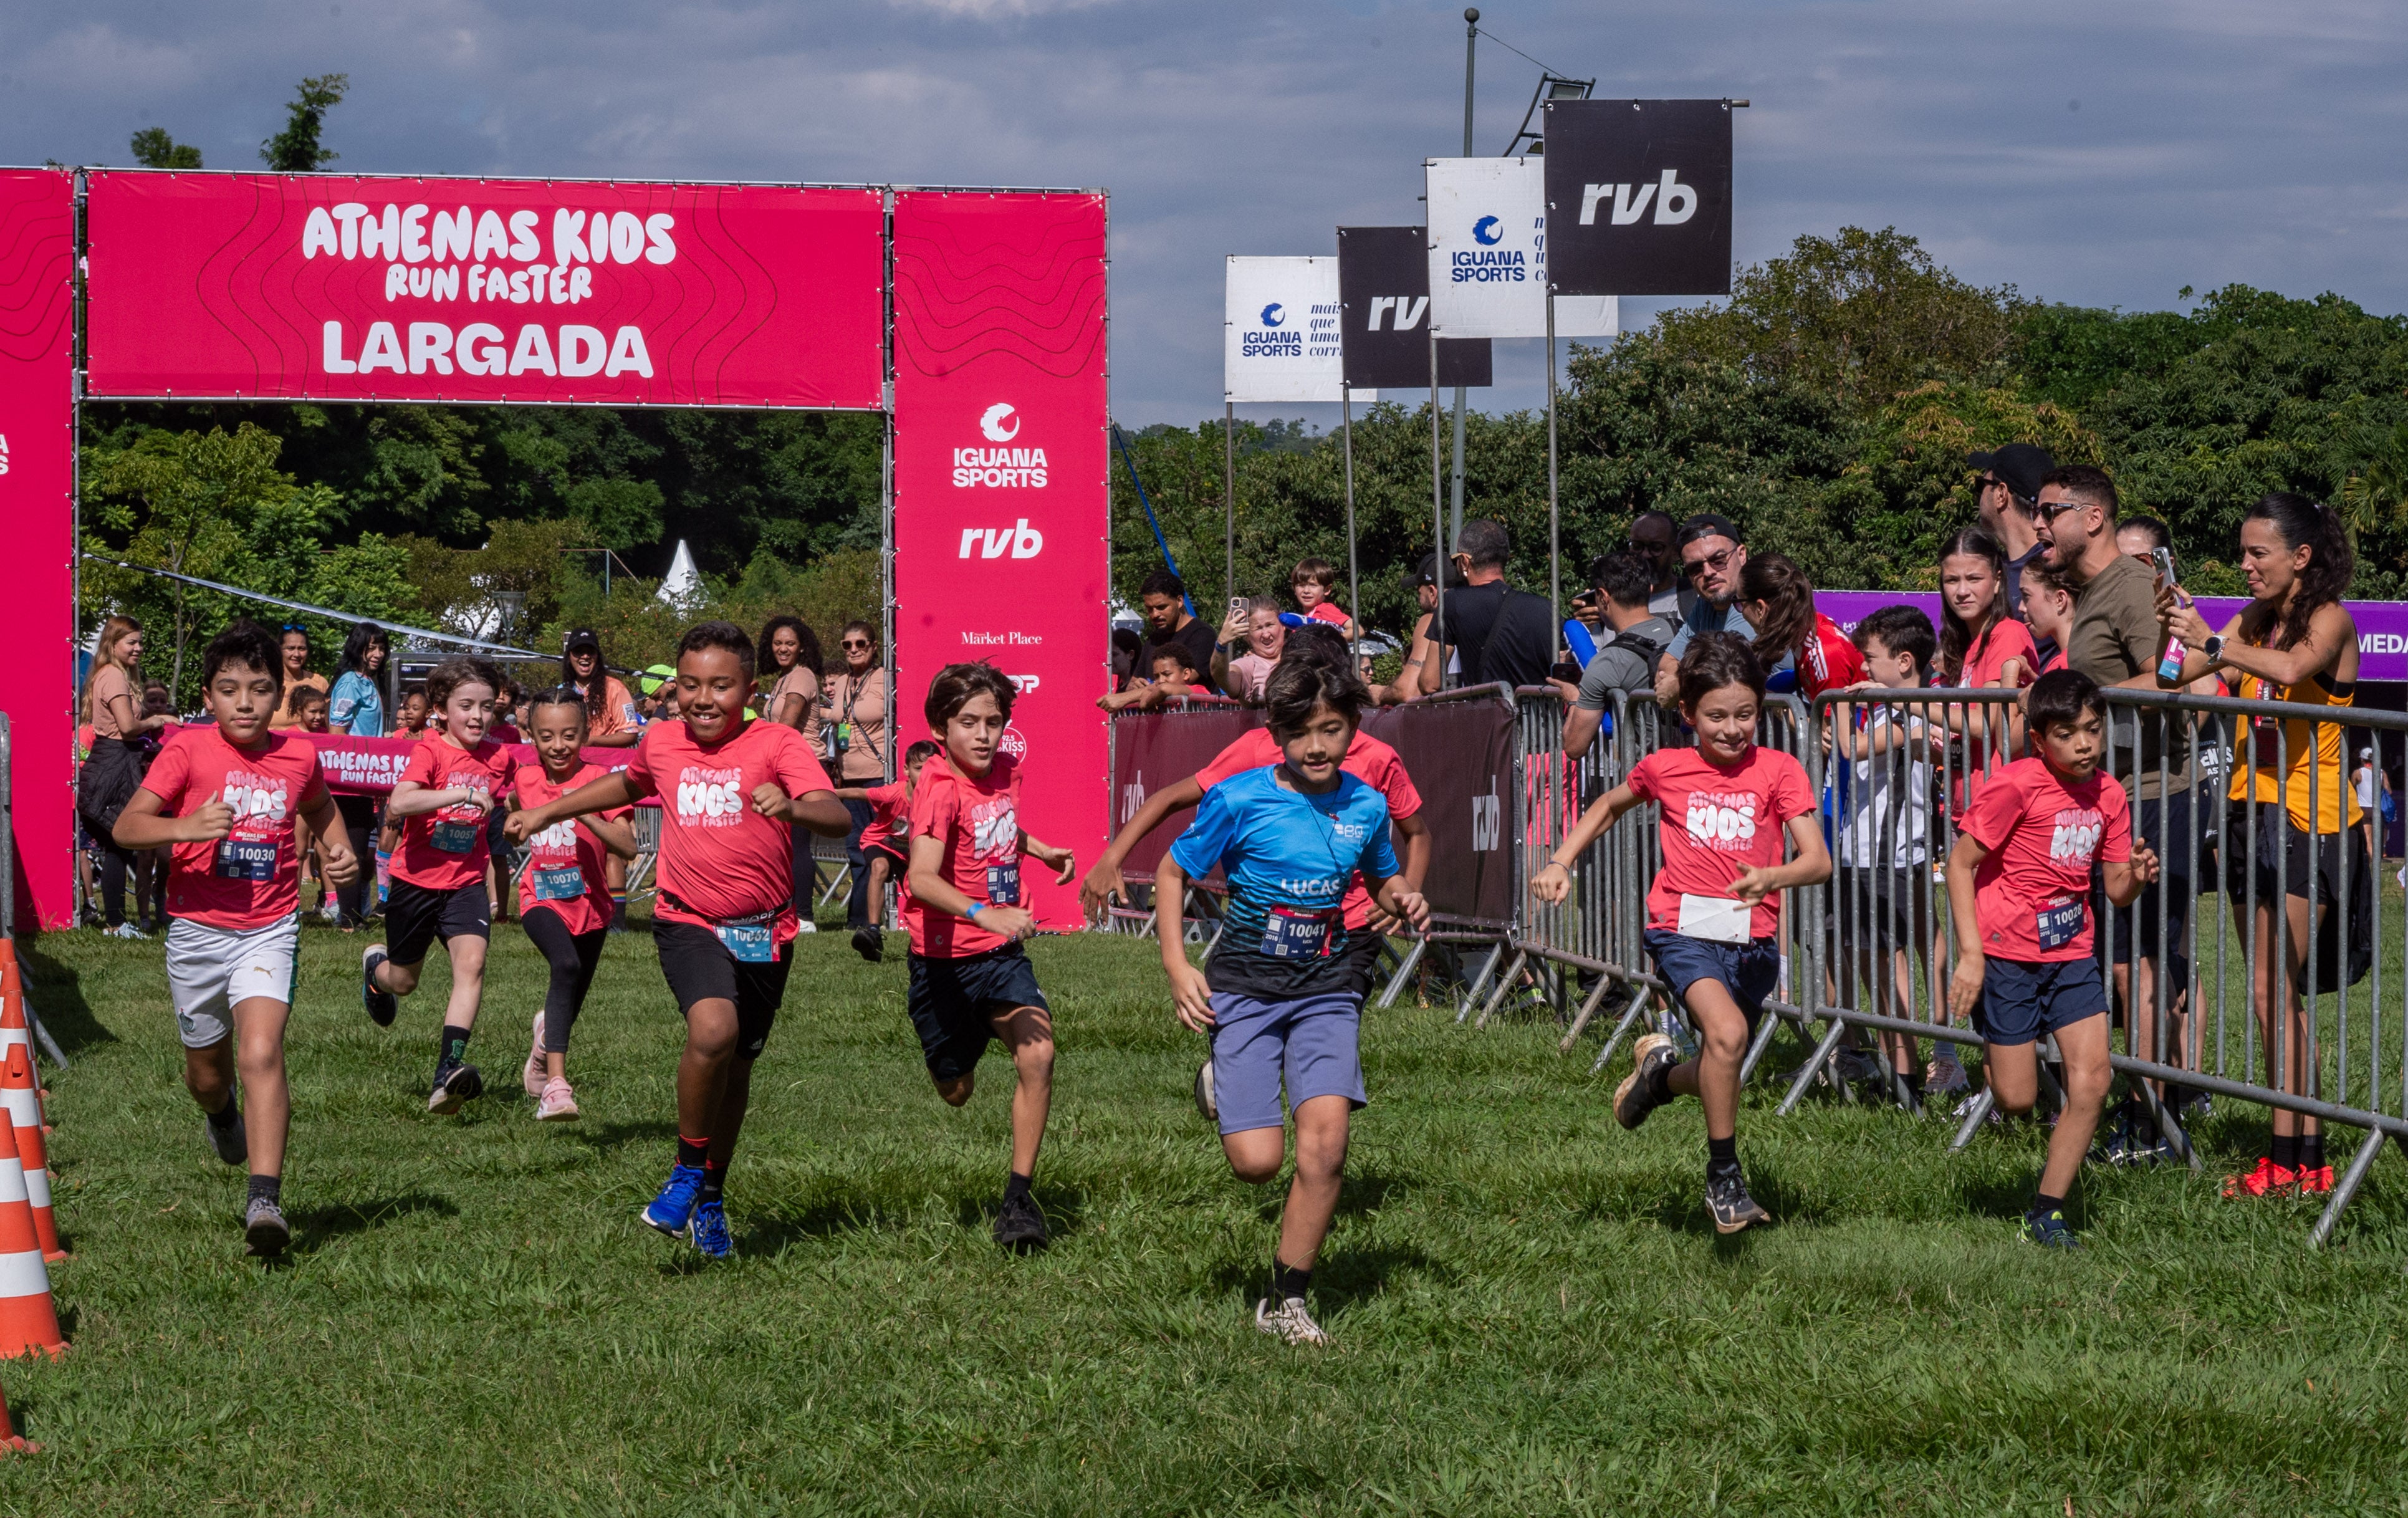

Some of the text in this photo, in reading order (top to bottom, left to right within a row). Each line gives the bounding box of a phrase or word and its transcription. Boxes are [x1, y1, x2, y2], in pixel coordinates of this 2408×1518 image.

[1579, 169, 1697, 226] rvb
[302, 203, 676, 267] ATHENAS KIDS
[1452, 251, 1525, 266] IGUANA
[385, 263, 593, 304] RUN FASTER
[1451, 267, 1525, 282] SPORTS
[1368, 296, 1429, 331] rv
[1310, 318, 1335, 332] que
[1243, 331, 1302, 343] IGUANA
[1310, 332, 1340, 343] uma
[323, 320, 654, 378] LARGADA
[1242, 344, 1302, 357] SPORTS
[954, 448, 1048, 468] IGUANA
[952, 467, 1048, 488] SPORTS
[958, 518, 1043, 559] rvb
[961, 632, 1043, 645] Market Place
[1002, 741, 1024, 752] KISS
[226, 770, 287, 791] ATHENAS
[340, 769, 365, 783] RUN
[679, 766, 742, 784] ATHENAS
[223, 784, 287, 820] KIDS
[677, 781, 743, 817] KIDS
[1687, 791, 1756, 809] ATHENAS
[679, 812, 743, 827] RUN FASTER
[1472, 774, 1500, 852] rvb
[974, 810, 1017, 851] KIDS
[1686, 804, 1755, 842] KIDS
[449, 829, 476, 839] 10057
[2050, 824, 2101, 858] KIDS
[1714, 838, 1753, 852] FASTER
[238, 847, 276, 862] 10030
[547, 872, 580, 884] 10070
[1281, 878, 1340, 896] LUCAS
[2054, 903, 2083, 926] 10028
[1288, 923, 1326, 938] 10041
